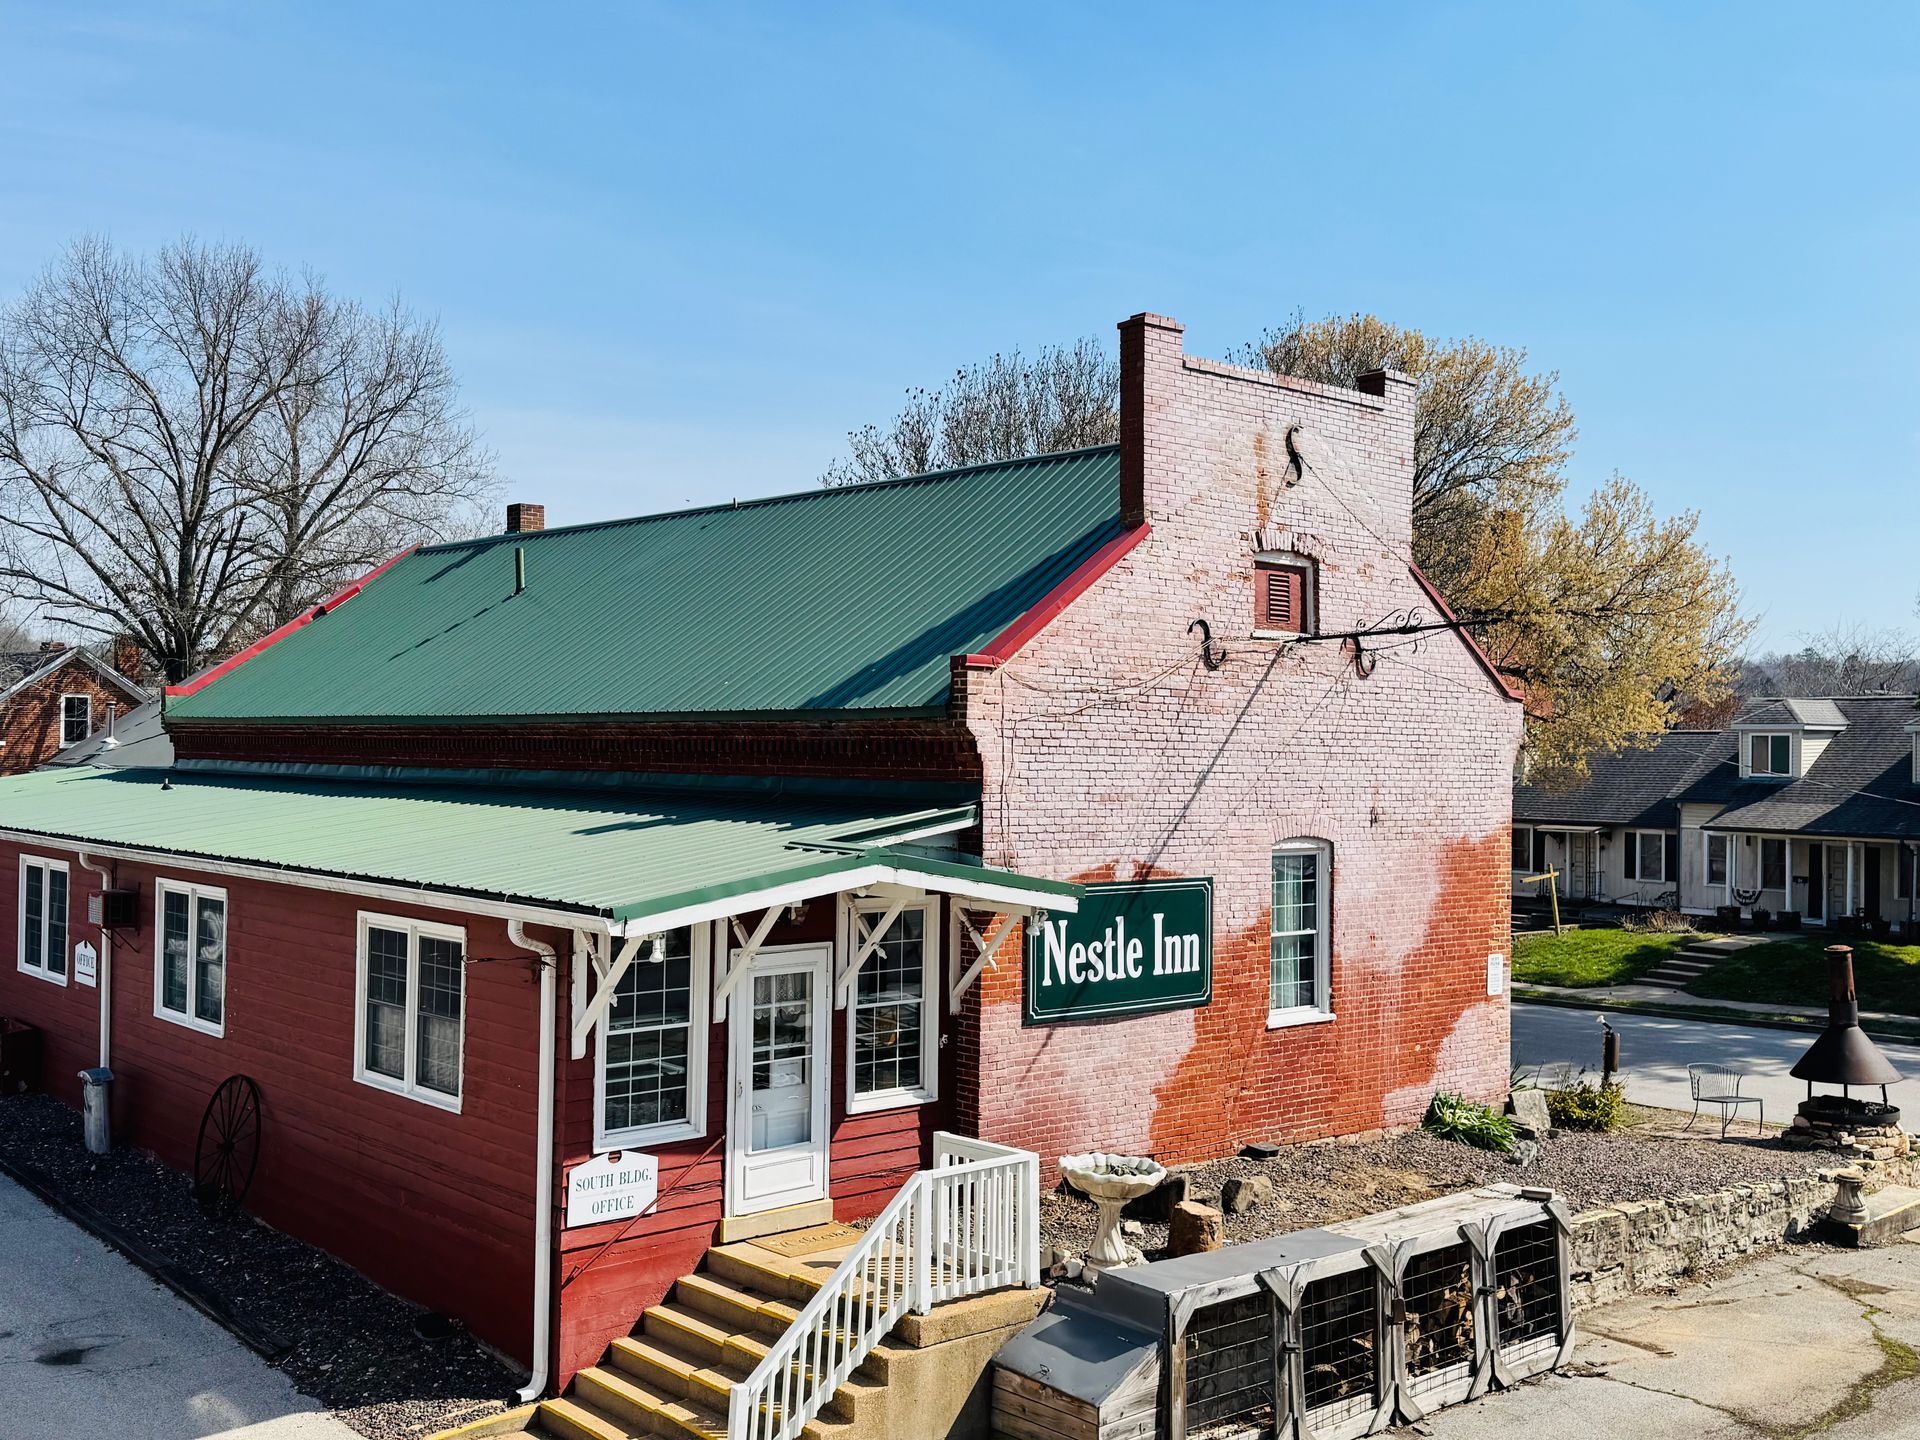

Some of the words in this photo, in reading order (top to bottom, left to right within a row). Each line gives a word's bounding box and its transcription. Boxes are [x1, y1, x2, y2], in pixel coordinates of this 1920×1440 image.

[1042, 915, 1143, 986] Nestle
[1152, 913, 1200, 975] Inn
[575, 1173, 614, 1192] SOUTH
[619, 1168, 652, 1186] BLDG.
[592, 1195, 634, 1214] OFFICE
